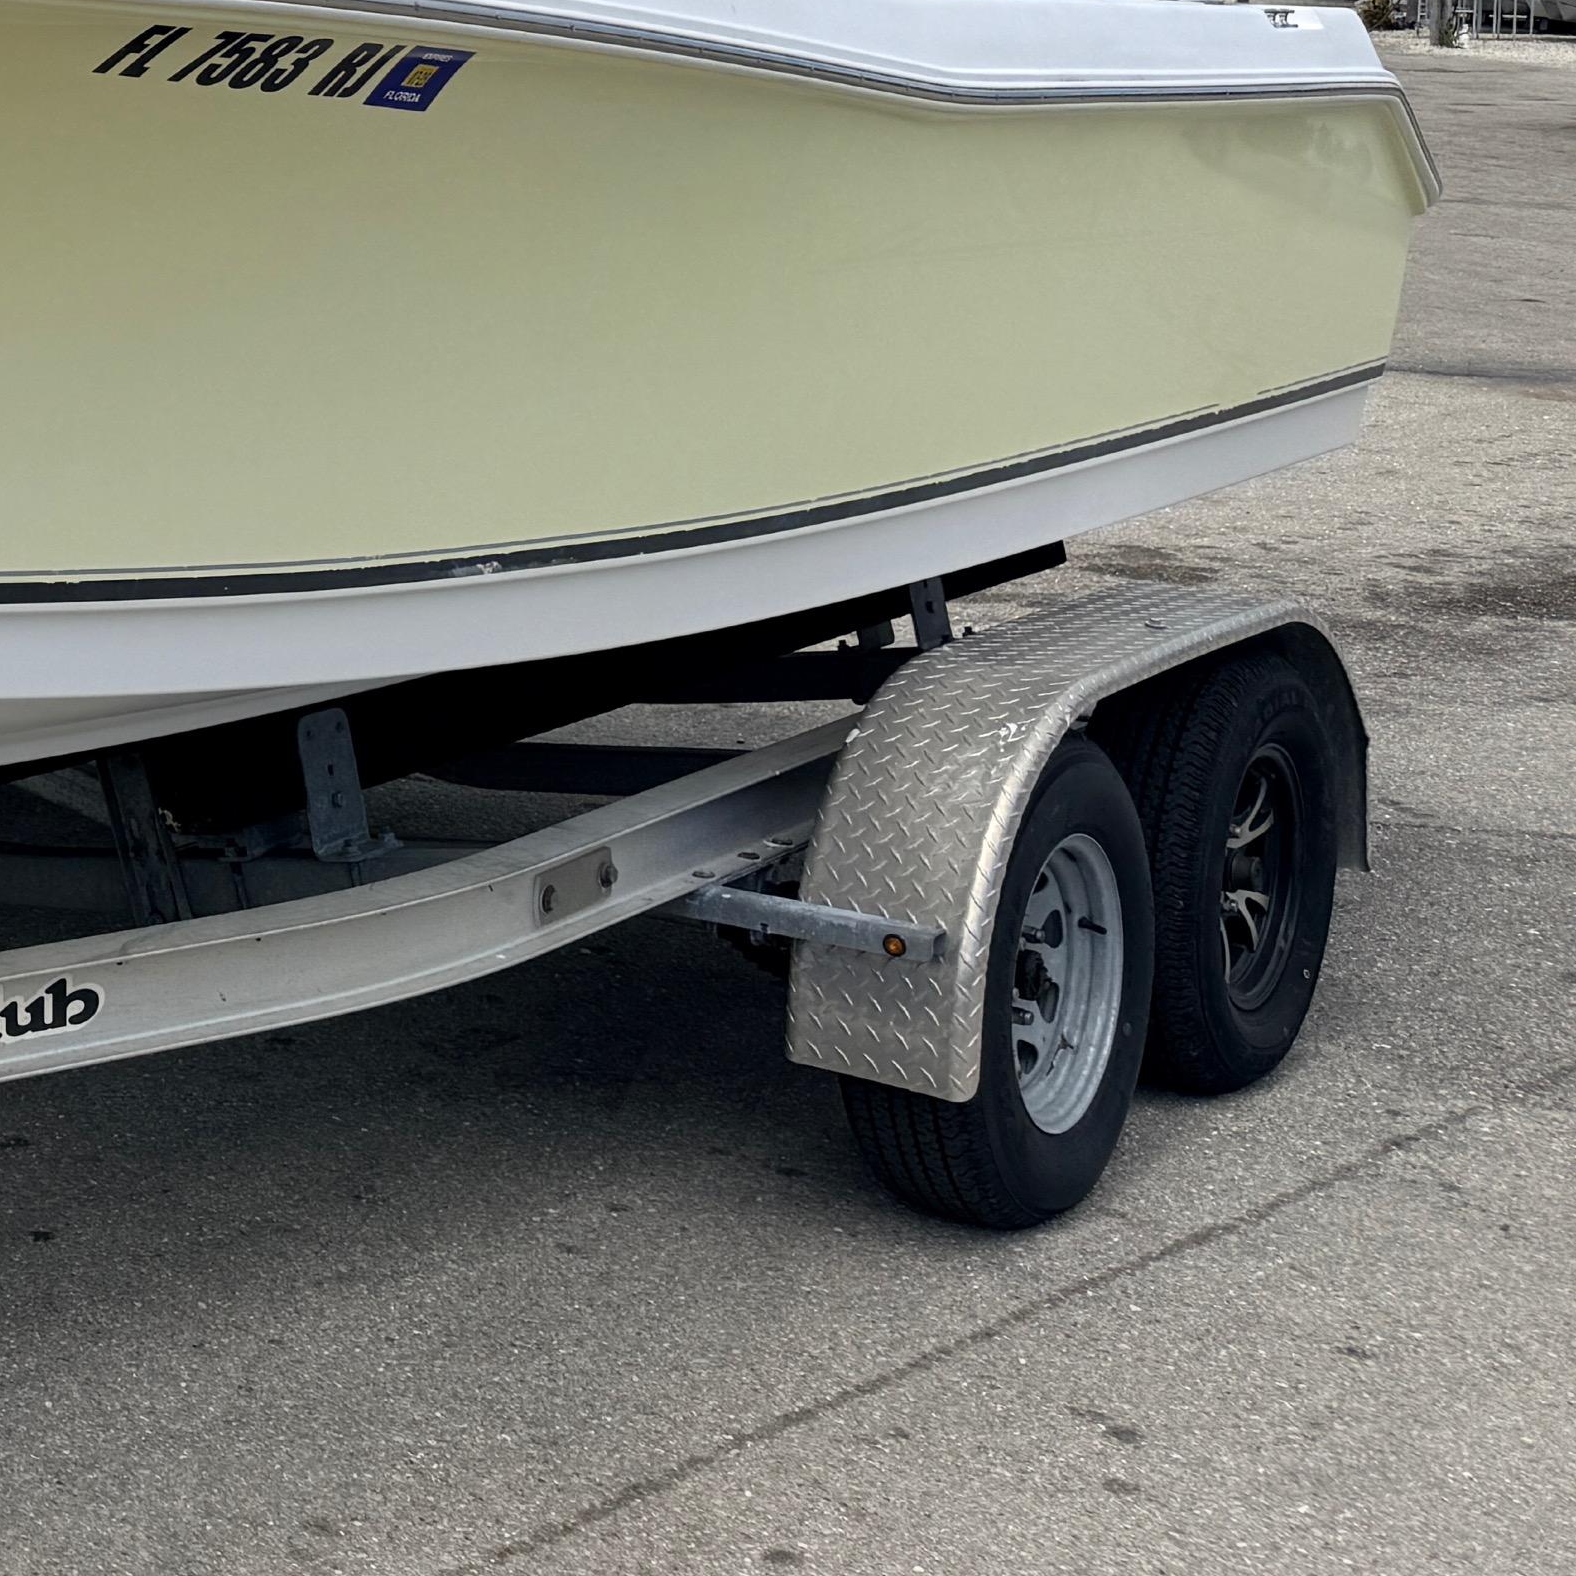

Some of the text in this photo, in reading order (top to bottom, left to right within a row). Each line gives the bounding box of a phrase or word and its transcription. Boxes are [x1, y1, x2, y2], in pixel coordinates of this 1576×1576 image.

[92, 25, 193, 78] FL
[167, 30, 335, 93] 7583
[308, 43, 407, 98] RJ
[383, 90, 422, 103] FLORIDA
